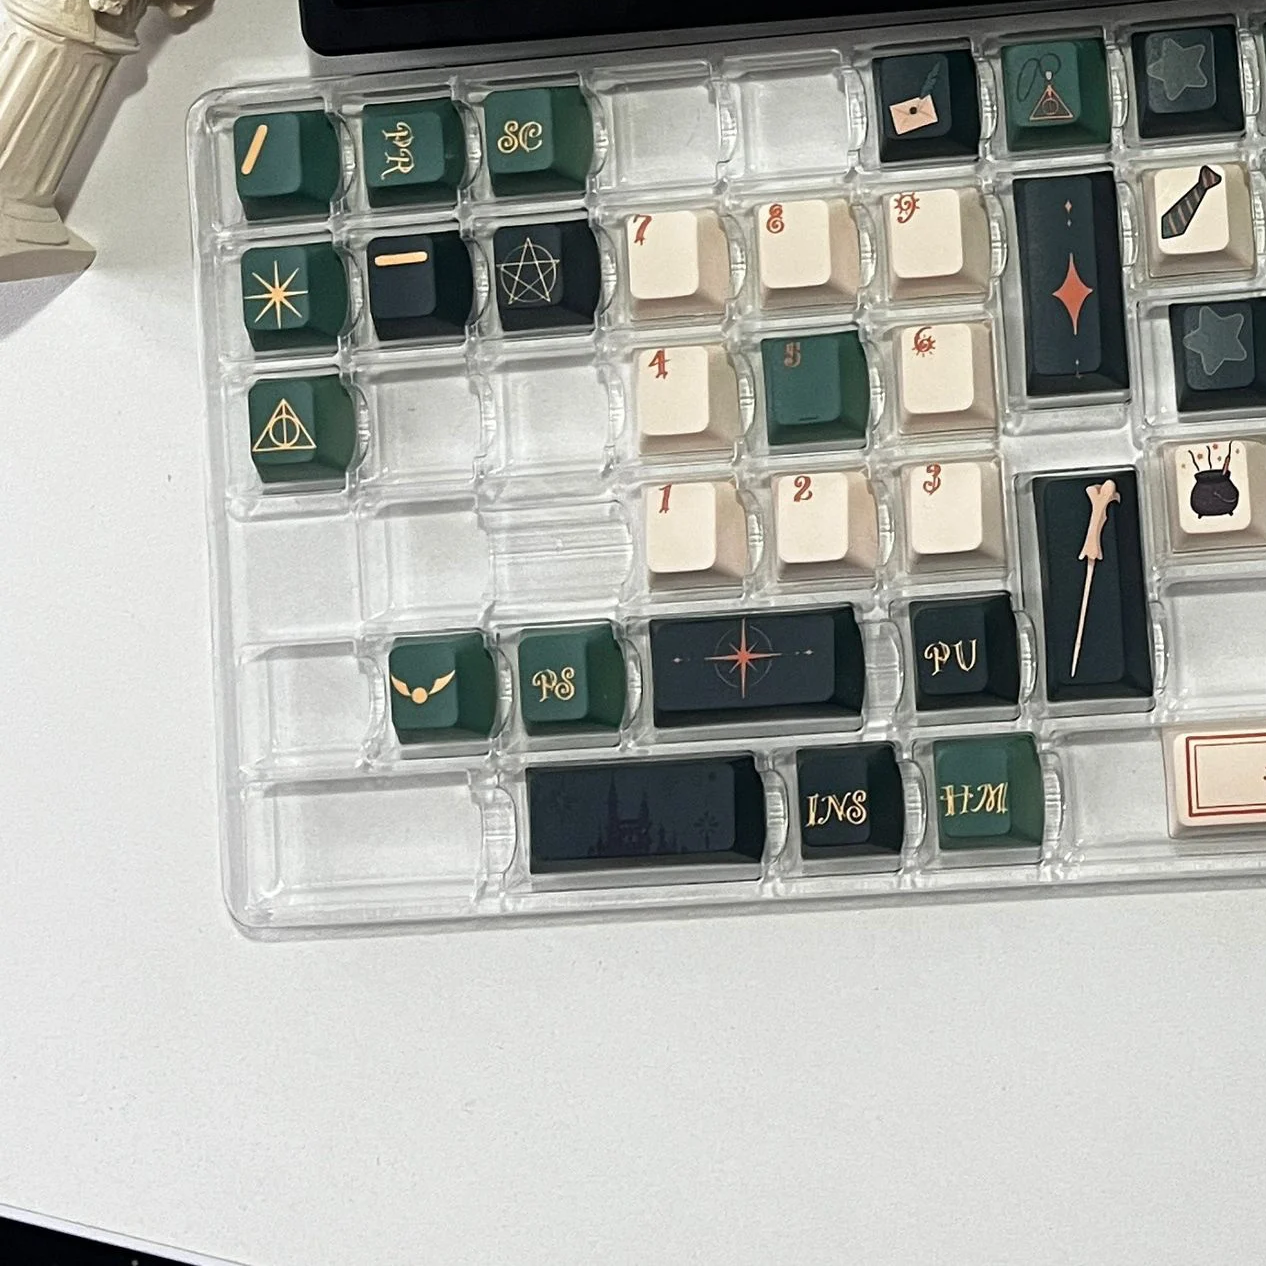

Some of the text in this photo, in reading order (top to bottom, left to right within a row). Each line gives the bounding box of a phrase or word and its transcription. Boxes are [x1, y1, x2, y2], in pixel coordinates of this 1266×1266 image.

[381, 121, 416, 181] PR
[497, 119, 544, 154] SC
[766, 202, 786, 235] 8
[892, 190, 921, 224] 9
[633, 214, 653, 245] 7
[783, 342, 802, 369] 5
[911, 326, 936, 357] 6
[647, 349, 669, 379] 4
[793, 475, 813, 503] 2
[922, 462, 943, 495] 3
[658, 484, 673, 514] 1
[924, 639, 978, 677] PU
[531, 666, 577, 702] PS
[805, 789, 868, 828] INS
[939, 782, 1009, 818] HM
